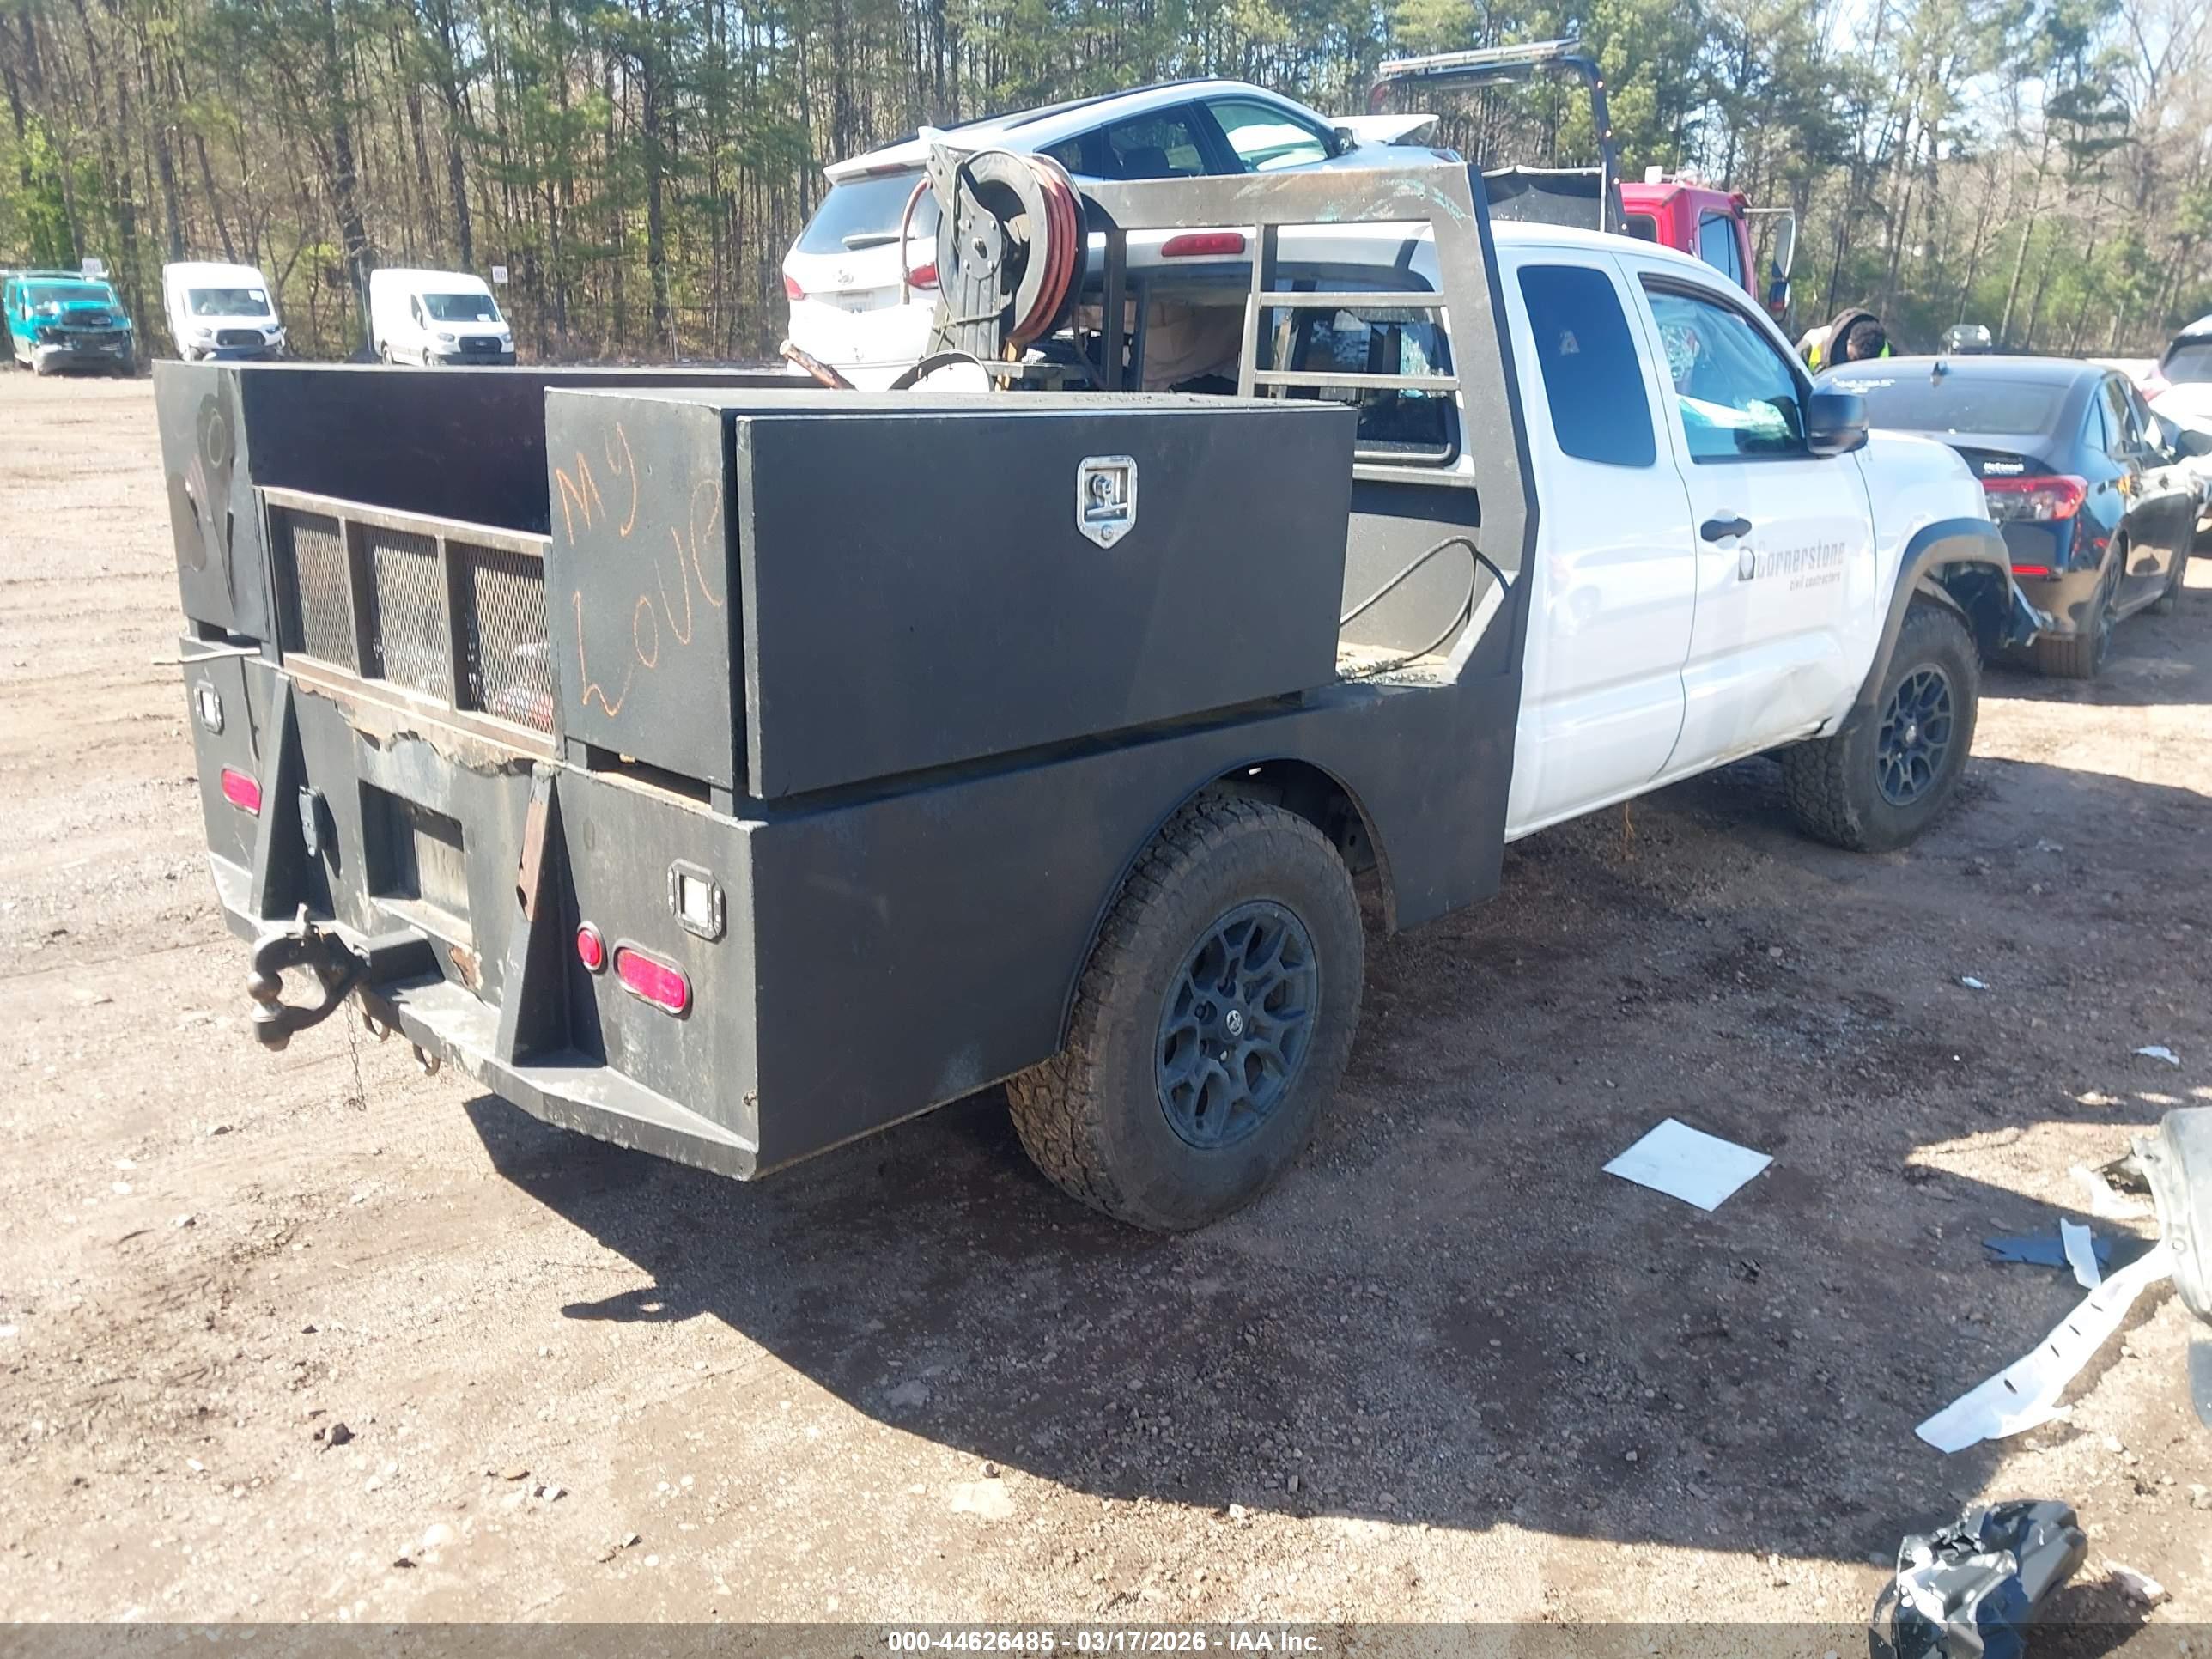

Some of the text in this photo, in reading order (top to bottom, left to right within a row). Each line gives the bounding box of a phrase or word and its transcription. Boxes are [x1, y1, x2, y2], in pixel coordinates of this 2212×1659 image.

[1756, 538, 1845, 579] Cornerstone
[1790, 571, 1841, 591] civil contractors
